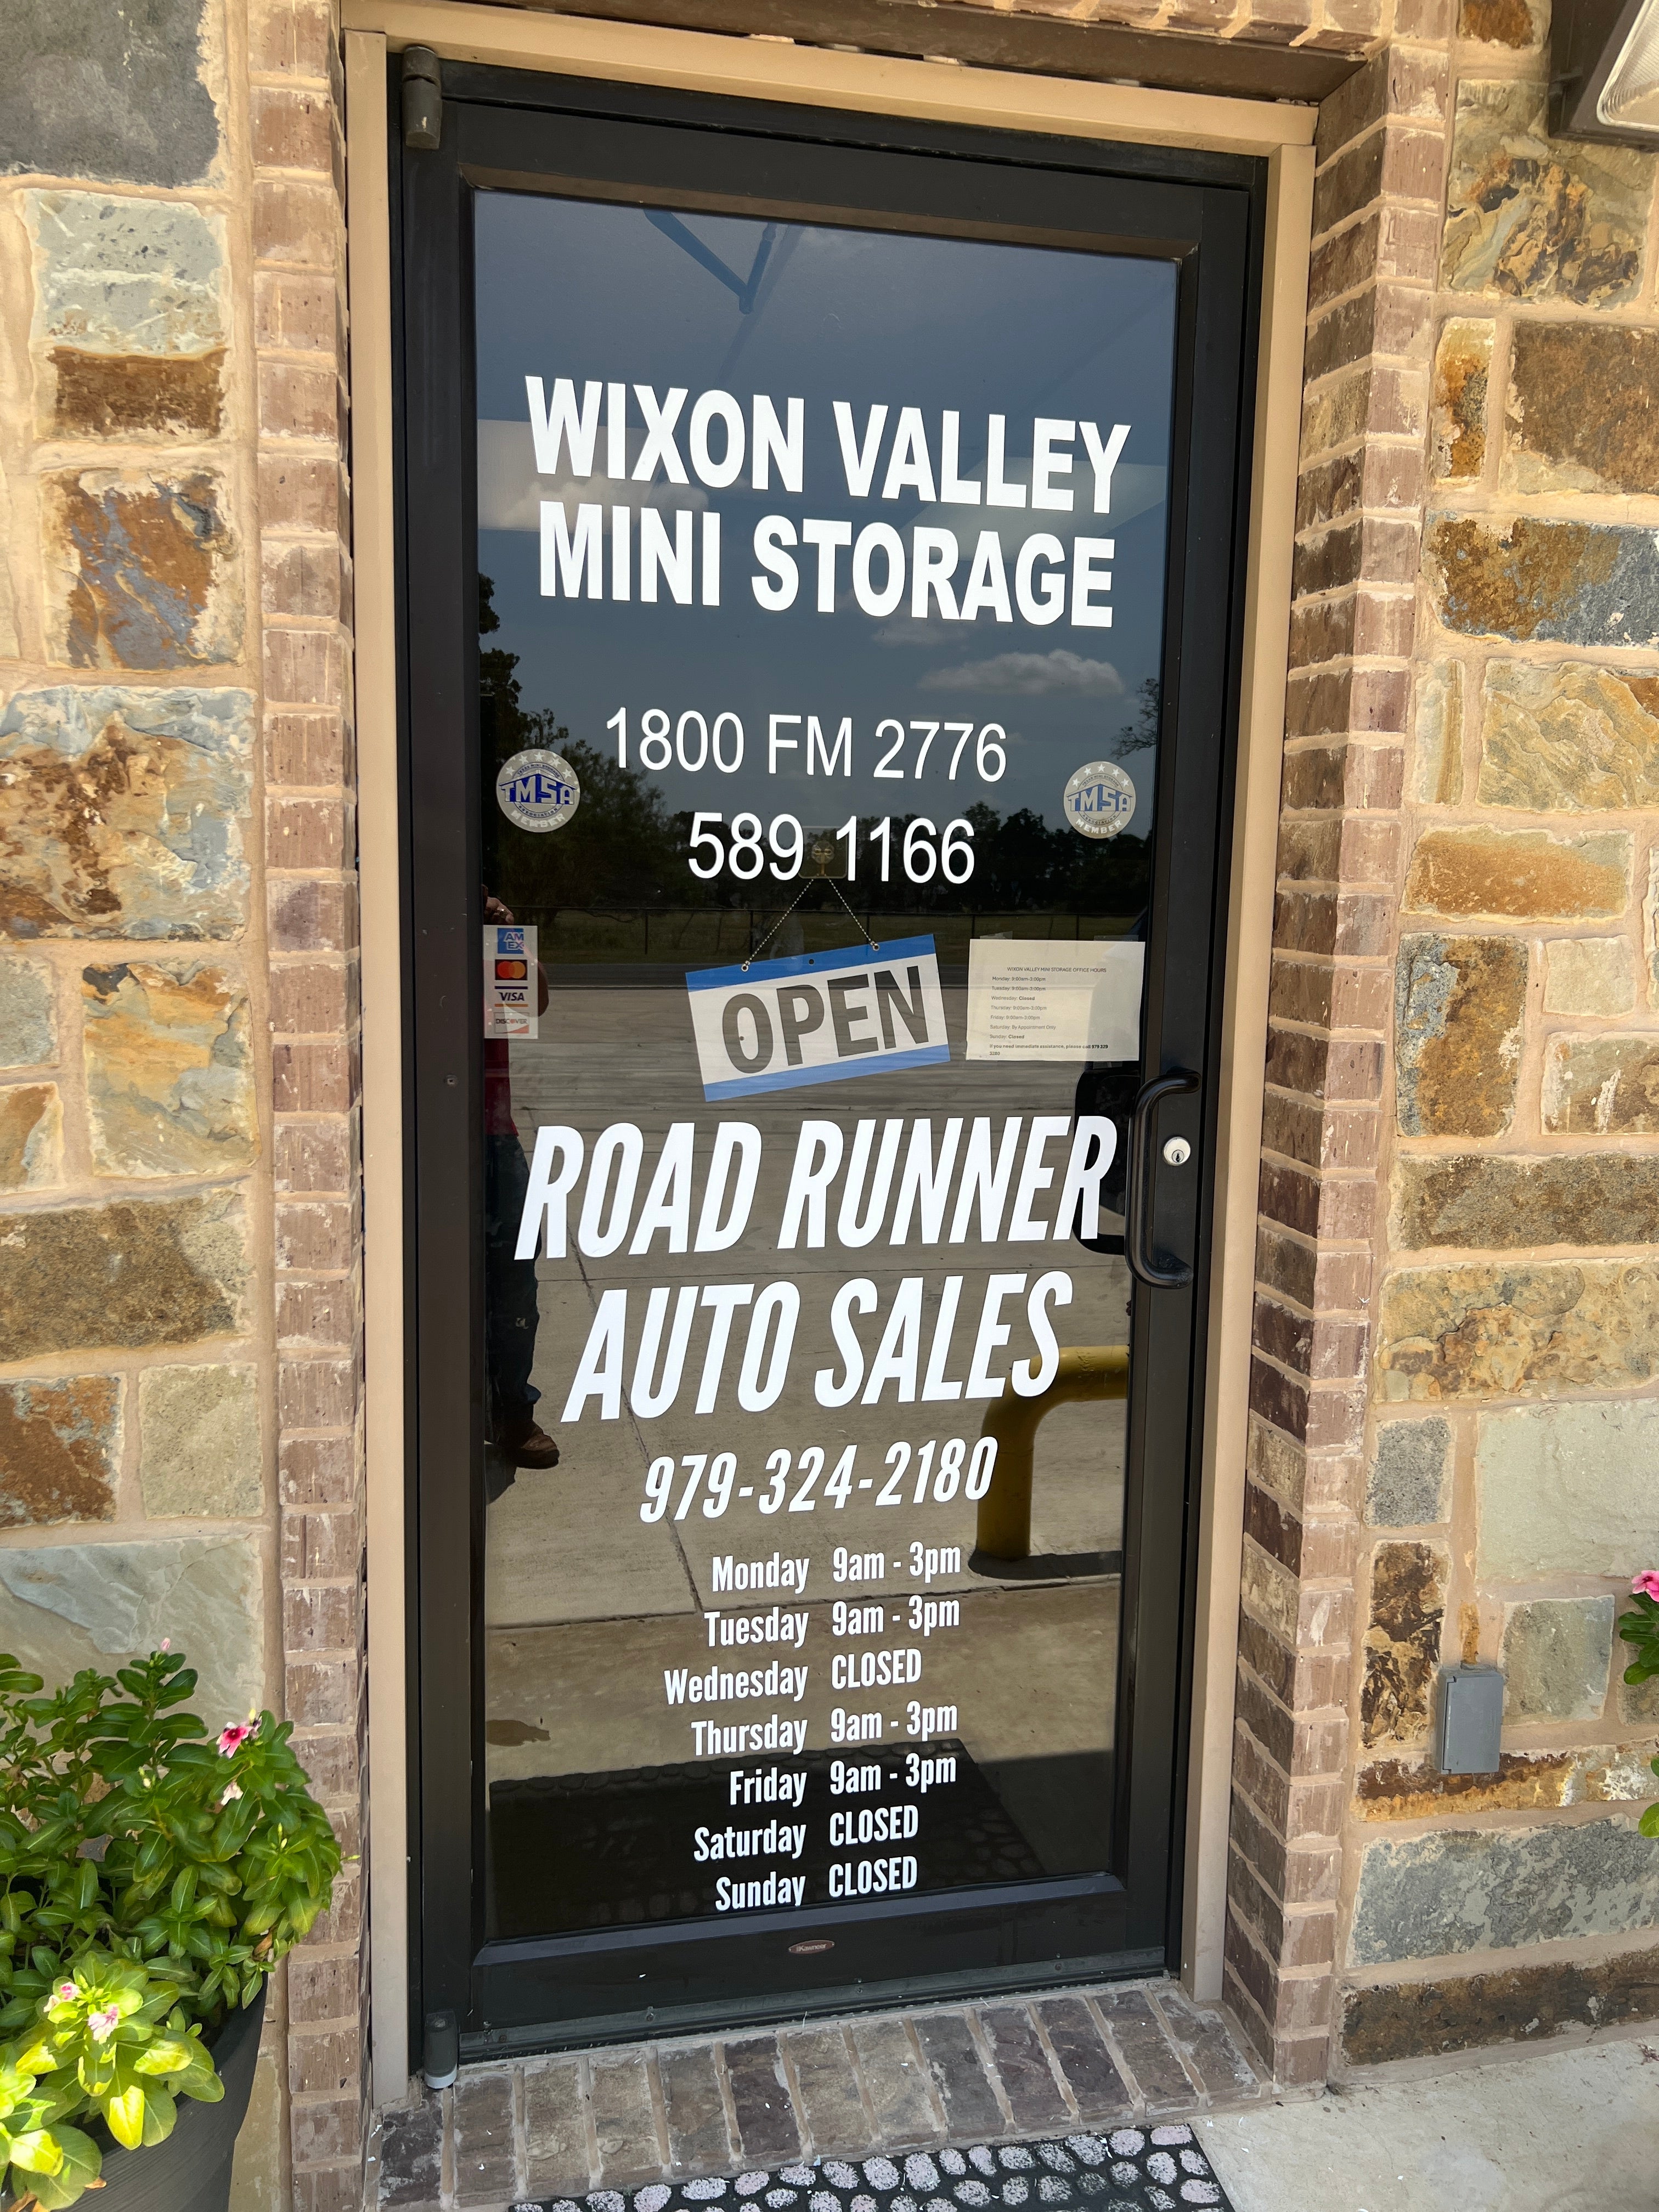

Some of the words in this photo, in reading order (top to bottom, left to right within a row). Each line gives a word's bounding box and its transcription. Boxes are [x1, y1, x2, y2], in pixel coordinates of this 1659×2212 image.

[526, 376, 804, 492] WIXON
[833, 402, 1131, 514] VALLEY
[540, 501, 720, 606] MINI
[752, 516, 1114, 627] STORAGE
[607, 708, 743, 772] 1800
[769, 714, 851, 776] FM
[874, 720, 1006, 782] 2776
[501, 775, 574, 804] TMSA
[1068, 785, 1131, 811] TMSA
[511, 810, 566, 827] MEMBER
[1075, 819, 1122, 834] MEMBER
[689, 812, 803, 880] 589
[837, 816, 974, 883] 1166
[505, 933, 524, 941] AM
[499, 992, 524, 1001] VISA
[723, 966, 929, 1074] OPEN
[515, 1122, 761, 1260] ROAD
[777, 1116, 1116, 1249] RUNNER
[561, 1282, 800, 1422] AUTO
[815, 1271, 1072, 1407] SALES
[640, 1437, 997, 1522] 979-324-2180
[713, 1552, 809, 1594] Monday
[833, 1547, 884, 1582] 9am
[910, 1542, 960, 1583] 3pm
[704, 1607, 809, 1647] Tuesday
[833, 1601, 883, 1635] 9am
[909, 1595, 959, 1636] 3pm
[664, 1661, 808, 1704] Wednesday
[832, 1649, 921, 1689] CLOSED
[691, 1714, 807, 1755] Thursday
[831, 1708, 882, 1742] 9am
[907, 1701, 957, 1741] 3pm
[731, 1768, 806, 1807] Friday
[831, 1761, 881, 1794] 9am
[906, 1753, 956, 1792] 3pm
[695, 1820, 806, 1860] Saturday
[830, 1805, 918, 1846] CLOSED
[716, 1872, 805, 1910] Sunday
[830, 1857, 917, 1897] CLOSED
